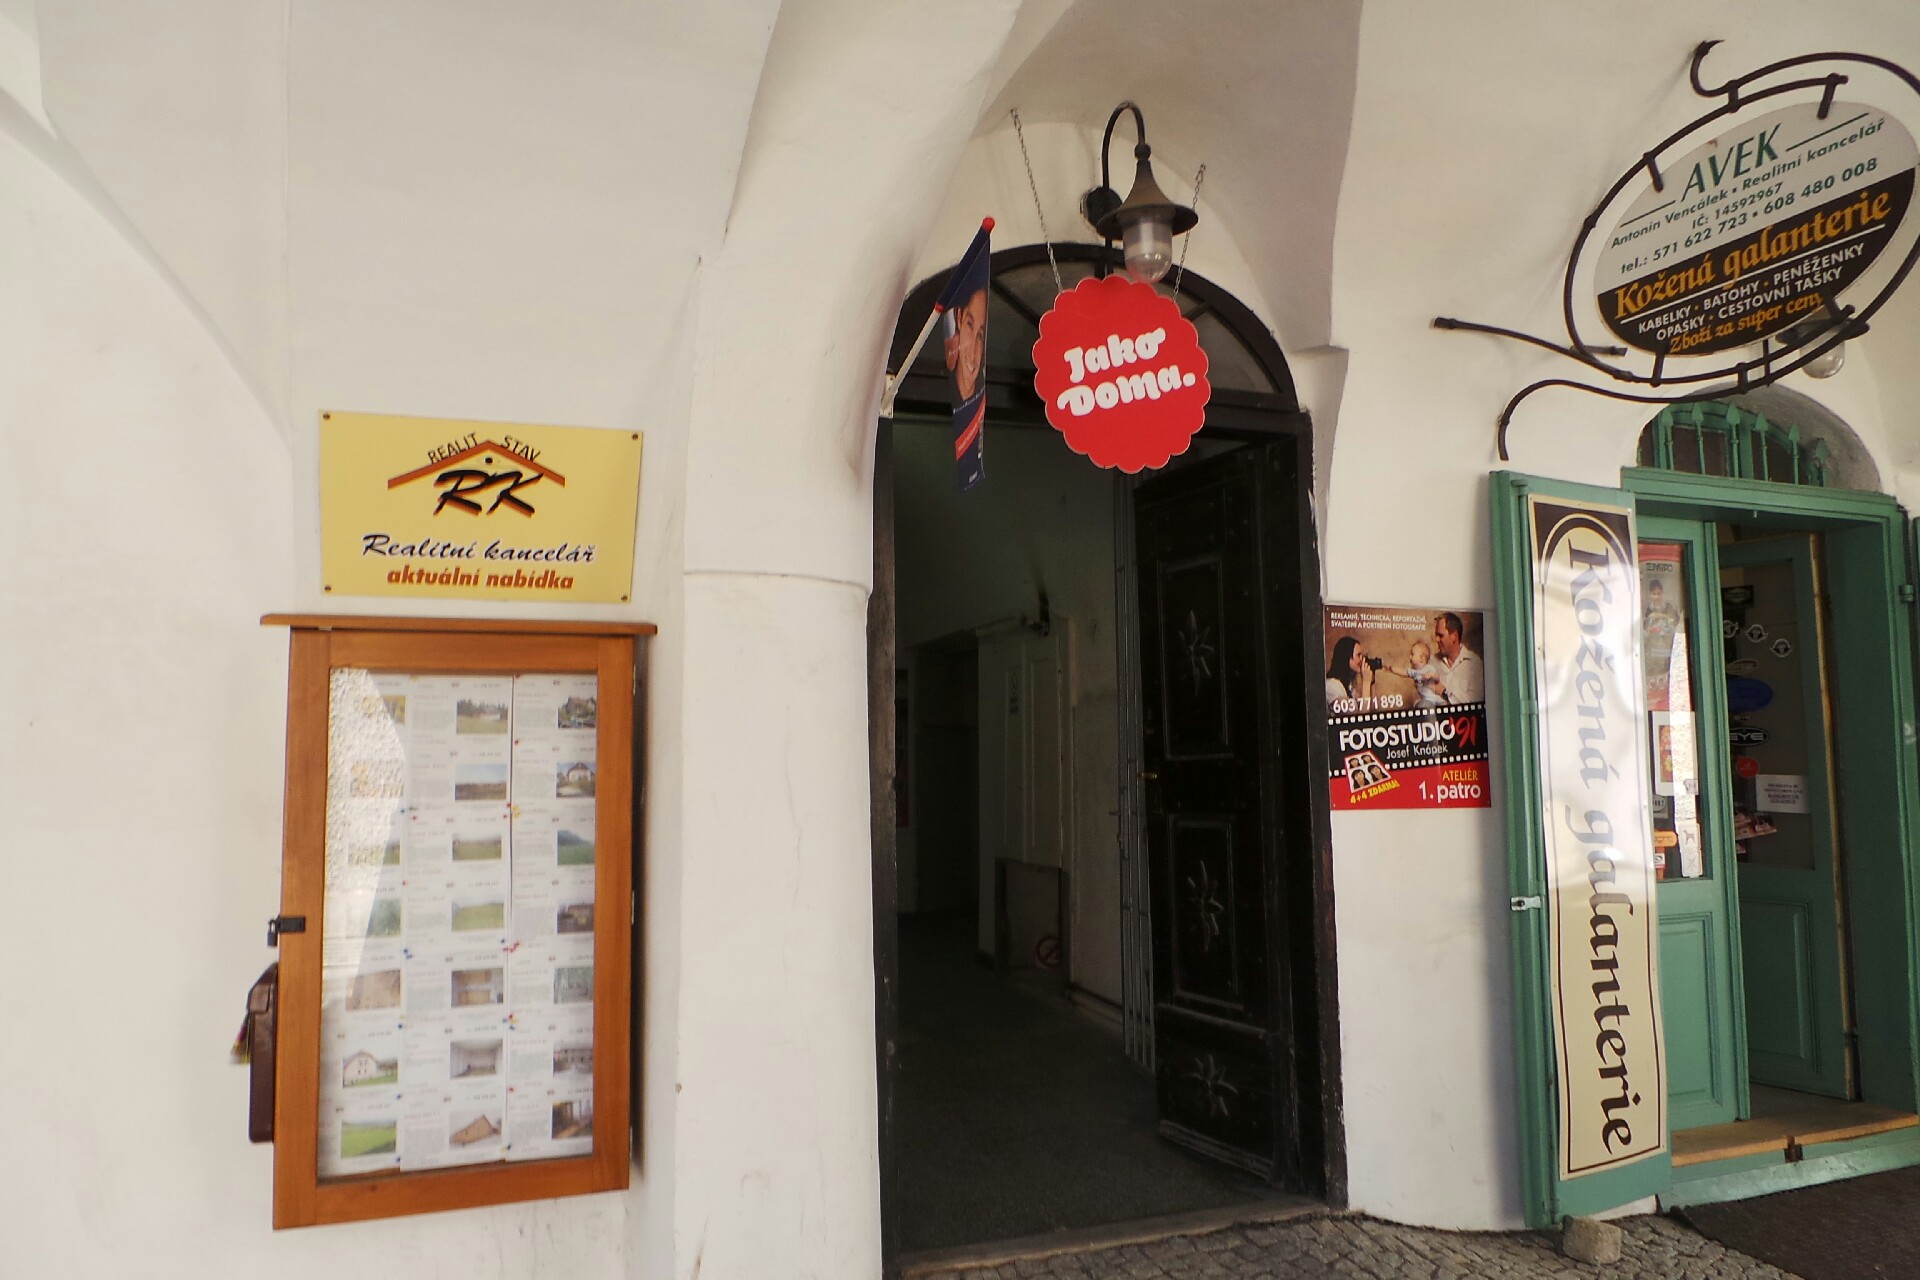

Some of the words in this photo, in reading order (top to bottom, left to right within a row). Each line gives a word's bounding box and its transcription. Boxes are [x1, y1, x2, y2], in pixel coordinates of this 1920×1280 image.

[1611, 221, 1661, 248] Antonín
[1665, 189, 1728, 224] Vencálek
[1742, 154, 1801, 190] Realitní
[1807, 117, 1885, 162] kancelář
[1680, 122, 1782, 203] AVEK
[1621, 255, 1648, 274] tel.:
[1652, 241, 1678, 261] 571
[1684, 227, 1712, 248] 622
[1718, 213, 1748, 234] 723
[1764, 192, 1795, 214] 608
[1801, 175, 1835, 198] 480
[1842, 157, 1877, 182] 008
[1715, 181, 1783, 220] 14592967
[1615, 252, 1716, 320] Kožená
[1722, 191, 1891, 290] galanterie
[1639, 304, 1691, 334] KABELKY
[1703, 280, 1760, 311] BATOHY
[1773, 242, 1864, 286] PENĚŽENKY
[1656, 314, 1705, 340] OPASKY
[1718, 281, 1790, 319] CESTOVNÍ
[1795, 266, 1843, 293] TAŠKY
[1715, 321, 1735, 337] za
[1737, 305, 1783, 332] super
[1063, 327, 1166, 384] Jako
[1056, 364, 1196, 417] Doma.
[428, 432, 480, 464] REALIT
[500, 435, 541, 462] STAV
[433, 469, 544, 518] RK
[362, 533, 477, 560] Realitní
[483, 540, 596, 563] kancelář
[387, 564, 480, 587] aktuální
[485, 568, 574, 589] nabídka
[1567, 538, 1620, 790] Kožená
[1339, 719, 1455, 752] FOTOSTUDIO
[1386, 745, 1410, 760] Josef
[1419, 781, 1434, 800] 1.
[1437, 782, 1481, 803] patro
[1442, 767, 1478, 782] ATELIÉR
[1565, 804, 1641, 1155] galanterie
